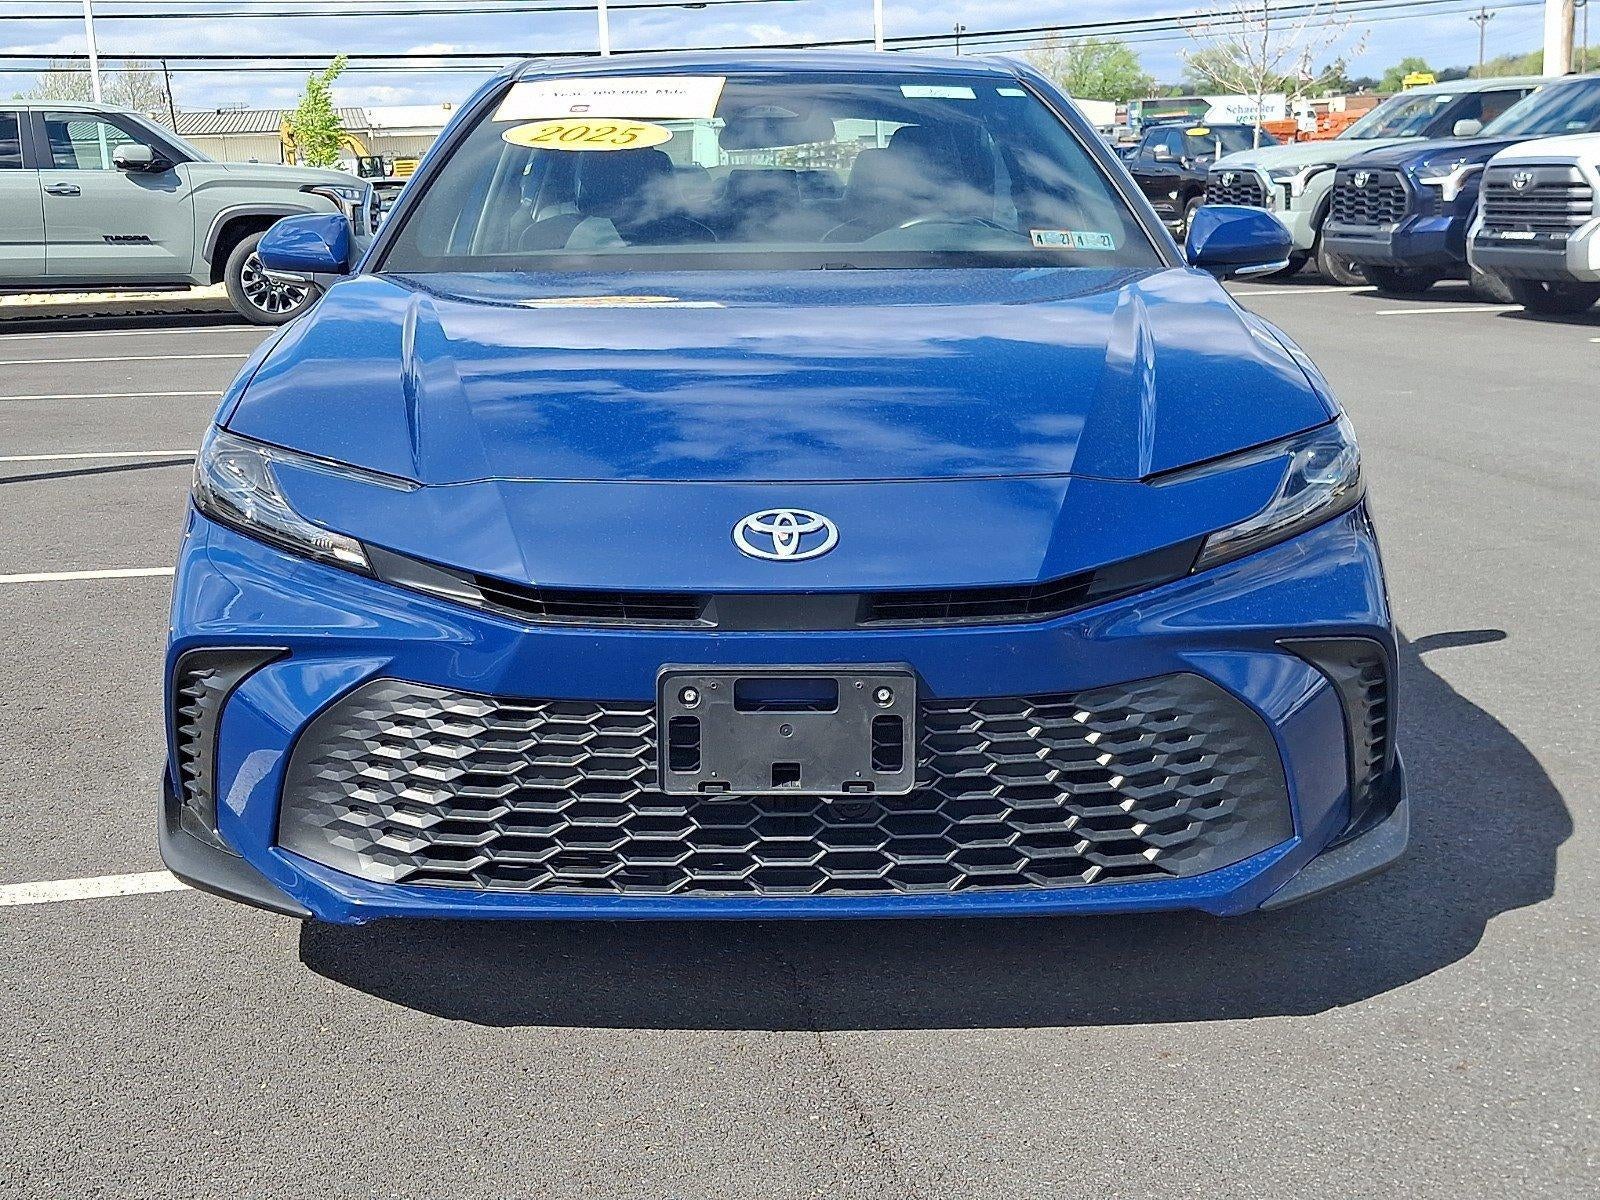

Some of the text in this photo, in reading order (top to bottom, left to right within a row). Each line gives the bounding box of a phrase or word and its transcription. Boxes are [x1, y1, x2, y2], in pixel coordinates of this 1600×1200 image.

[529, 125, 646, 145] 2025
[1060, 234, 1070, 246] 27
[1100, 235, 1111, 247] 27
